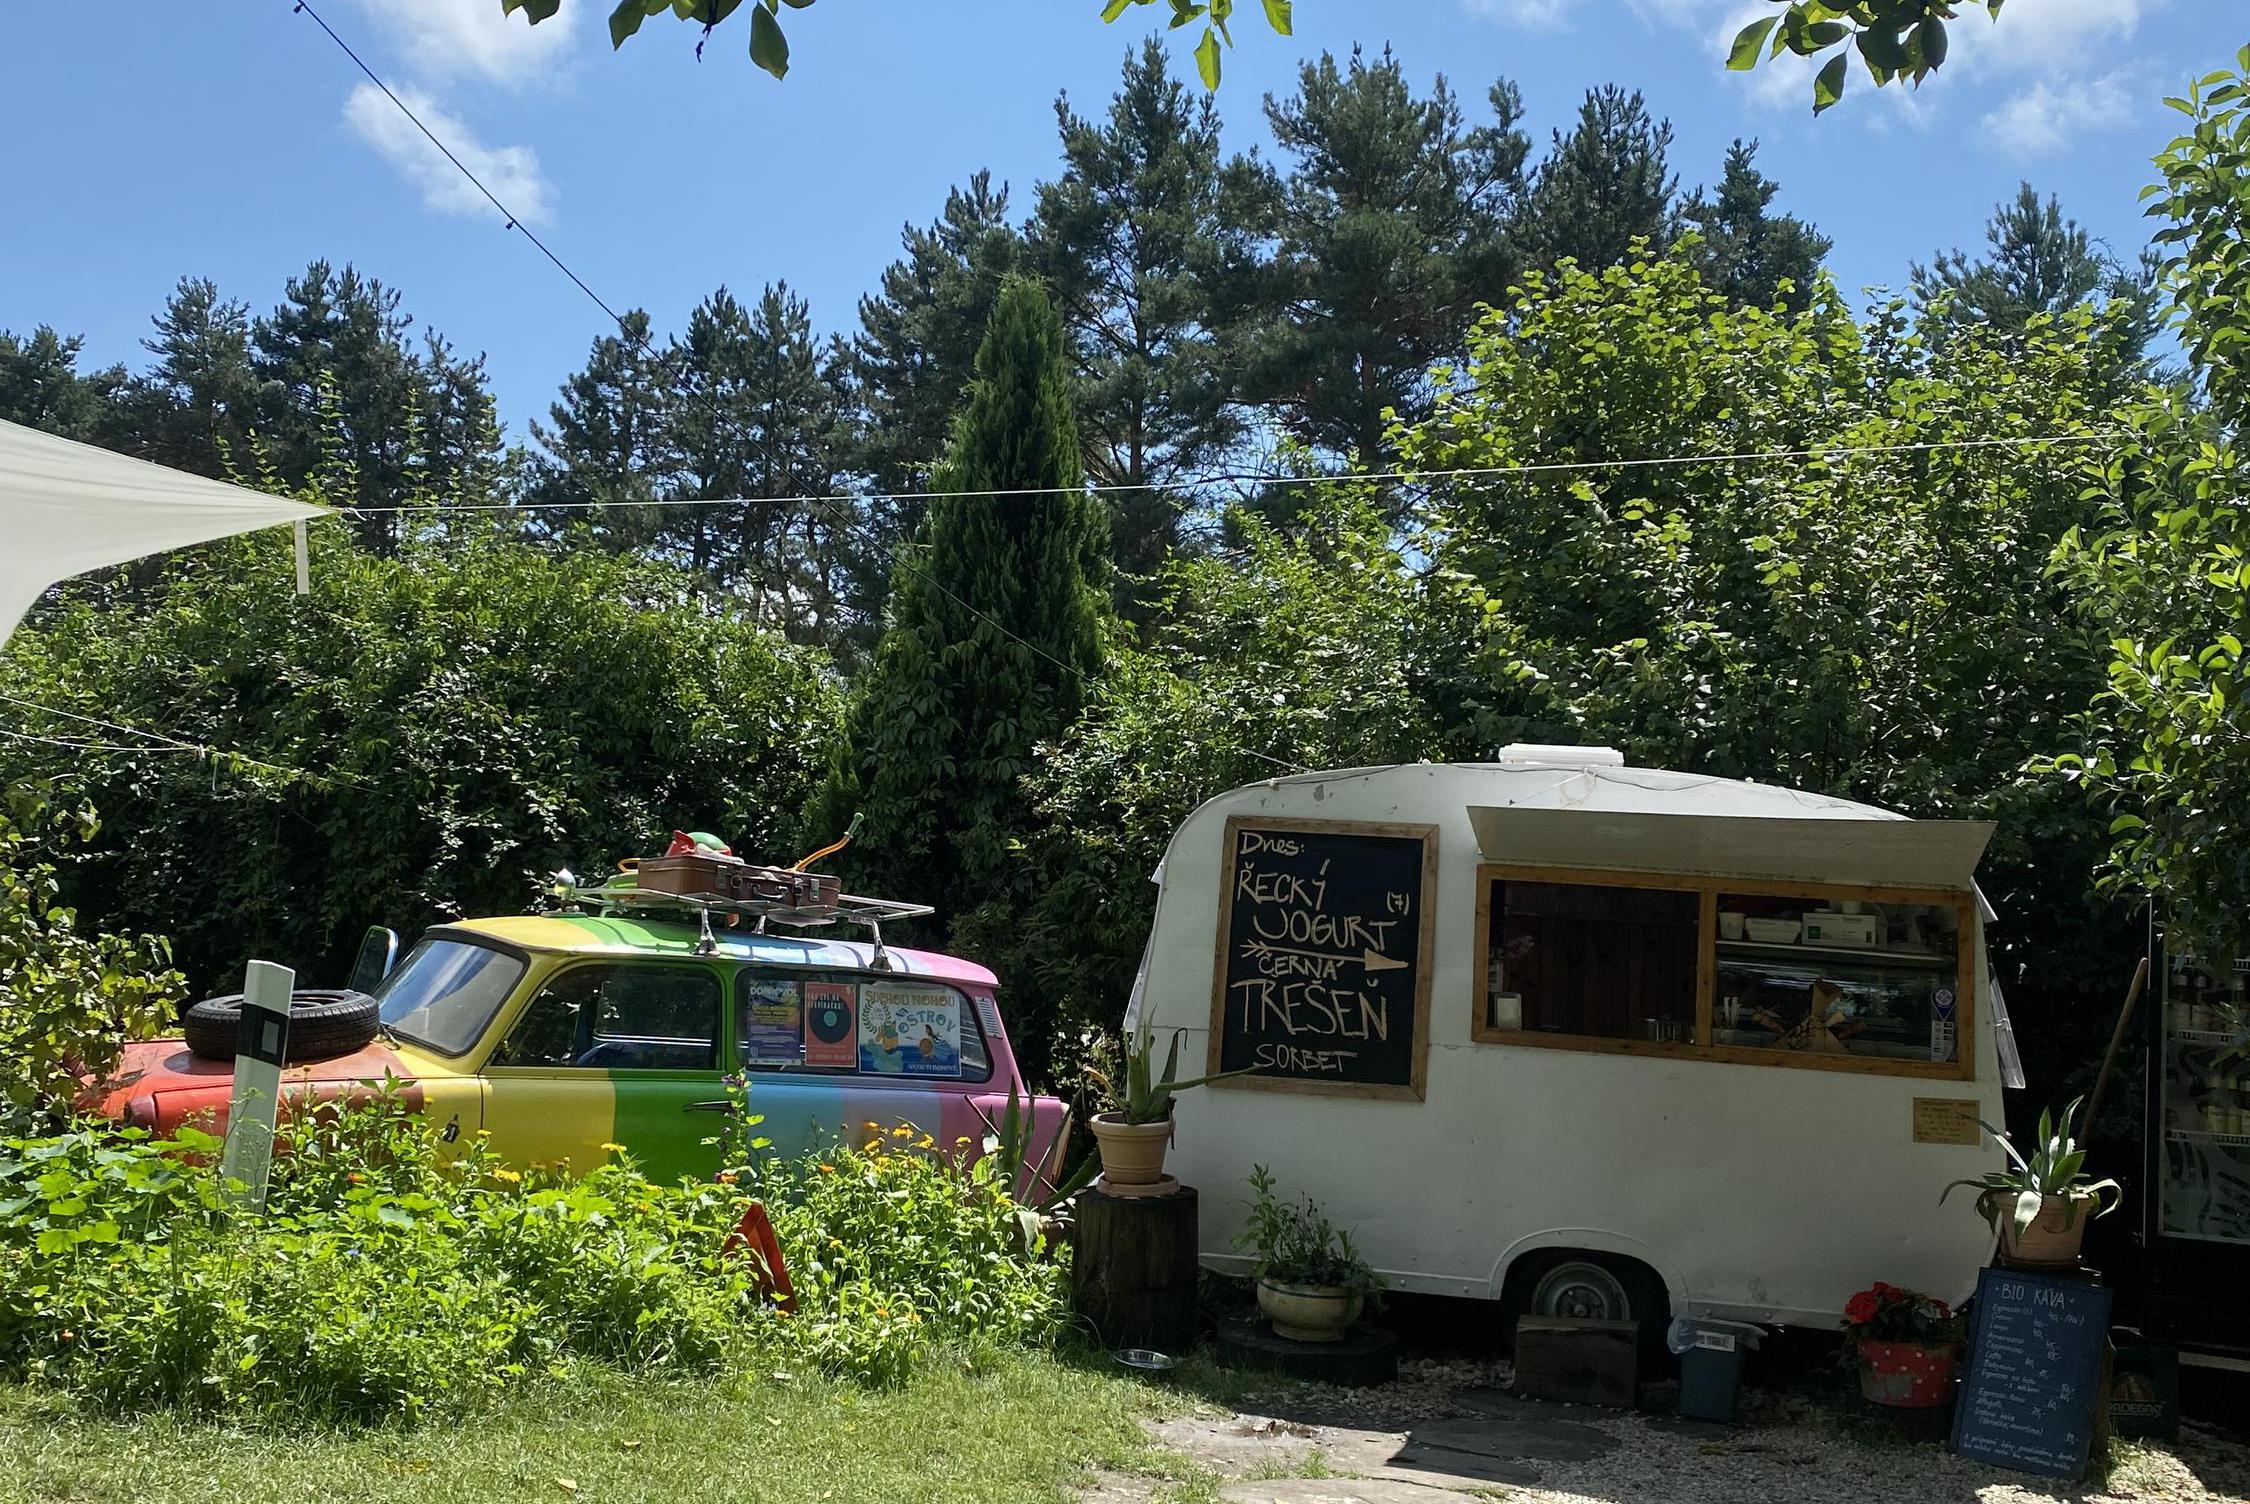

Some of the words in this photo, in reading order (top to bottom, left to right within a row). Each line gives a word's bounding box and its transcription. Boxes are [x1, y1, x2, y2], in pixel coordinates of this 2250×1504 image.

[1239, 831, 1305, 856] Dnes:
[1237, 858, 1331, 911] ŘECKÝ
[1253, 908, 1398, 953] JOGURT
[898, 1010, 956, 1034] OSTROV
[1252, 1043, 1359, 1073] SORBET
[2001, 1283, 2025, 1301] BIO
